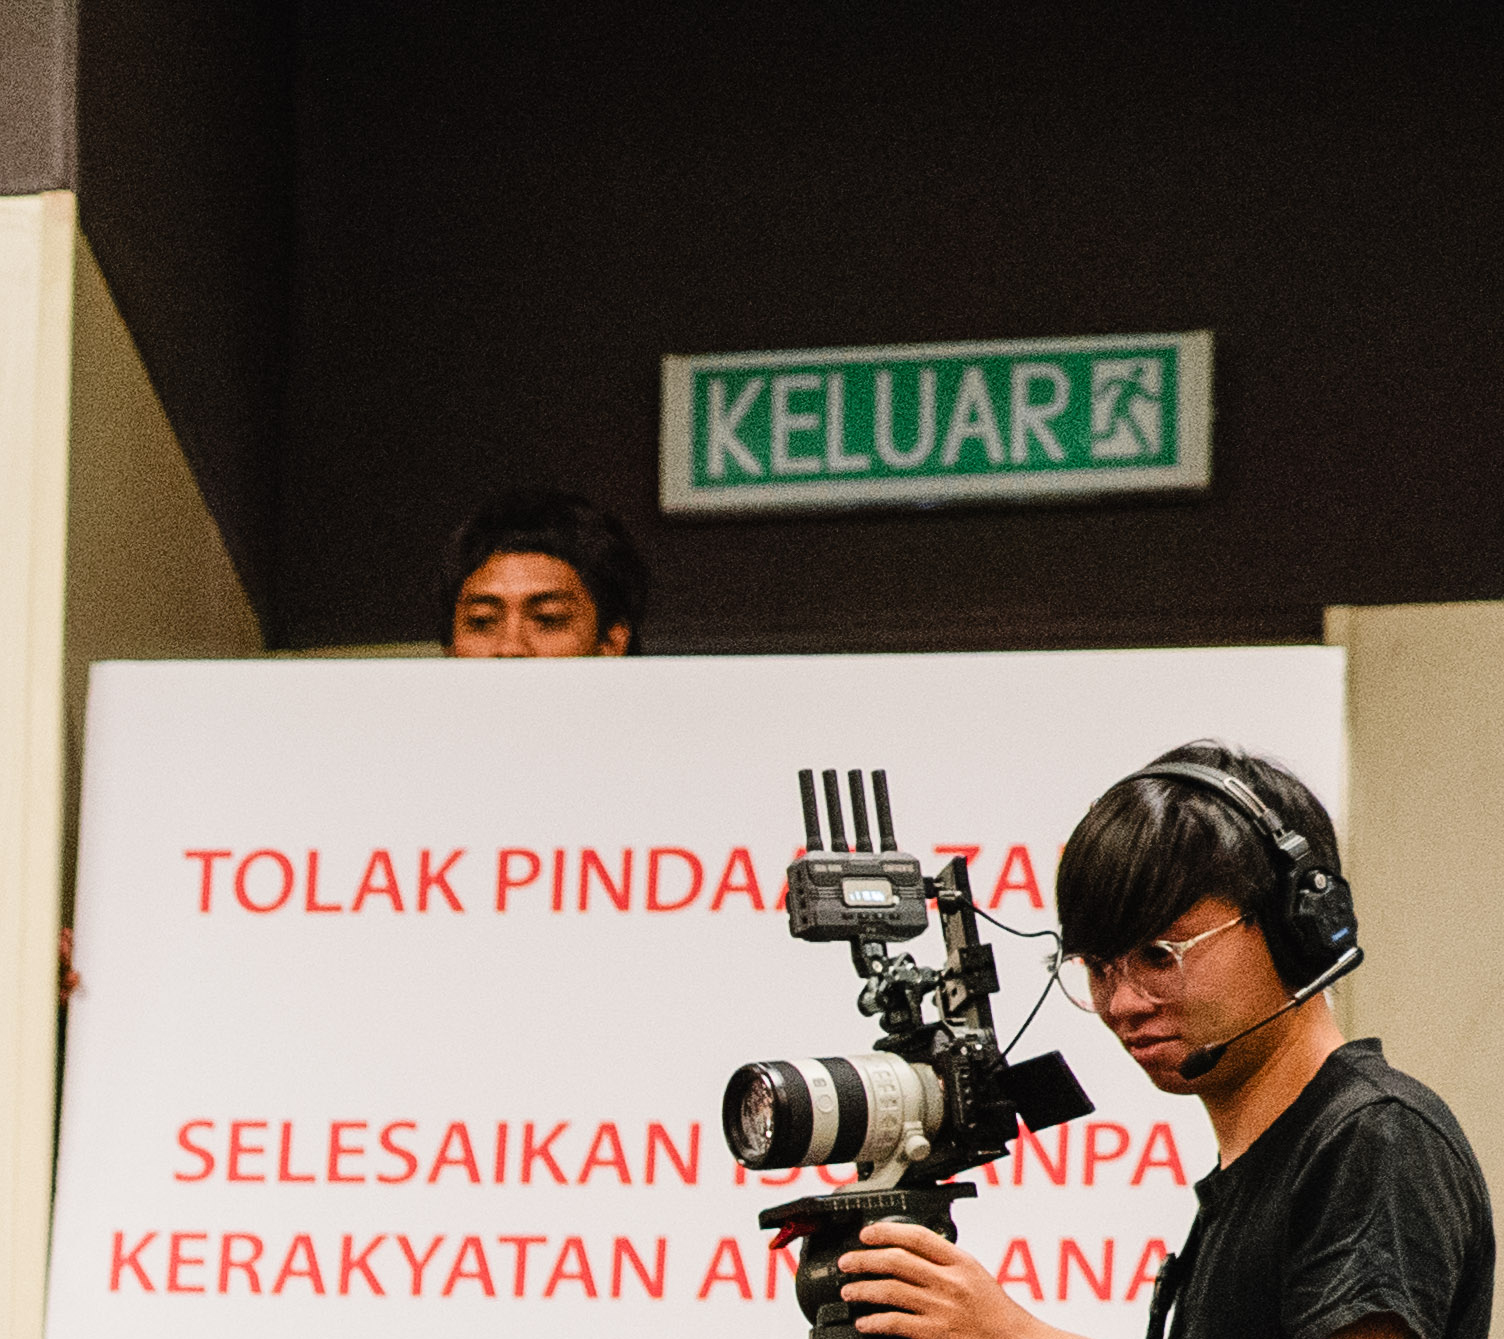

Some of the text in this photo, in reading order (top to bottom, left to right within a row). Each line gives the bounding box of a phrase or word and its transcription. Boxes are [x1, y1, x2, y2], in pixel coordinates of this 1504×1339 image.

[706, 363, 1070, 479] KELUAR
[184, 844, 1066, 914] TOLAK PINDA ZA
[174, 1119, 701, 1186] SELESAIKAN
[943, 1120, 1188, 1187] NPA
[108, 1231, 668, 1300] KERAKYATAN
[996, 1237, 1169, 1302] ANA
